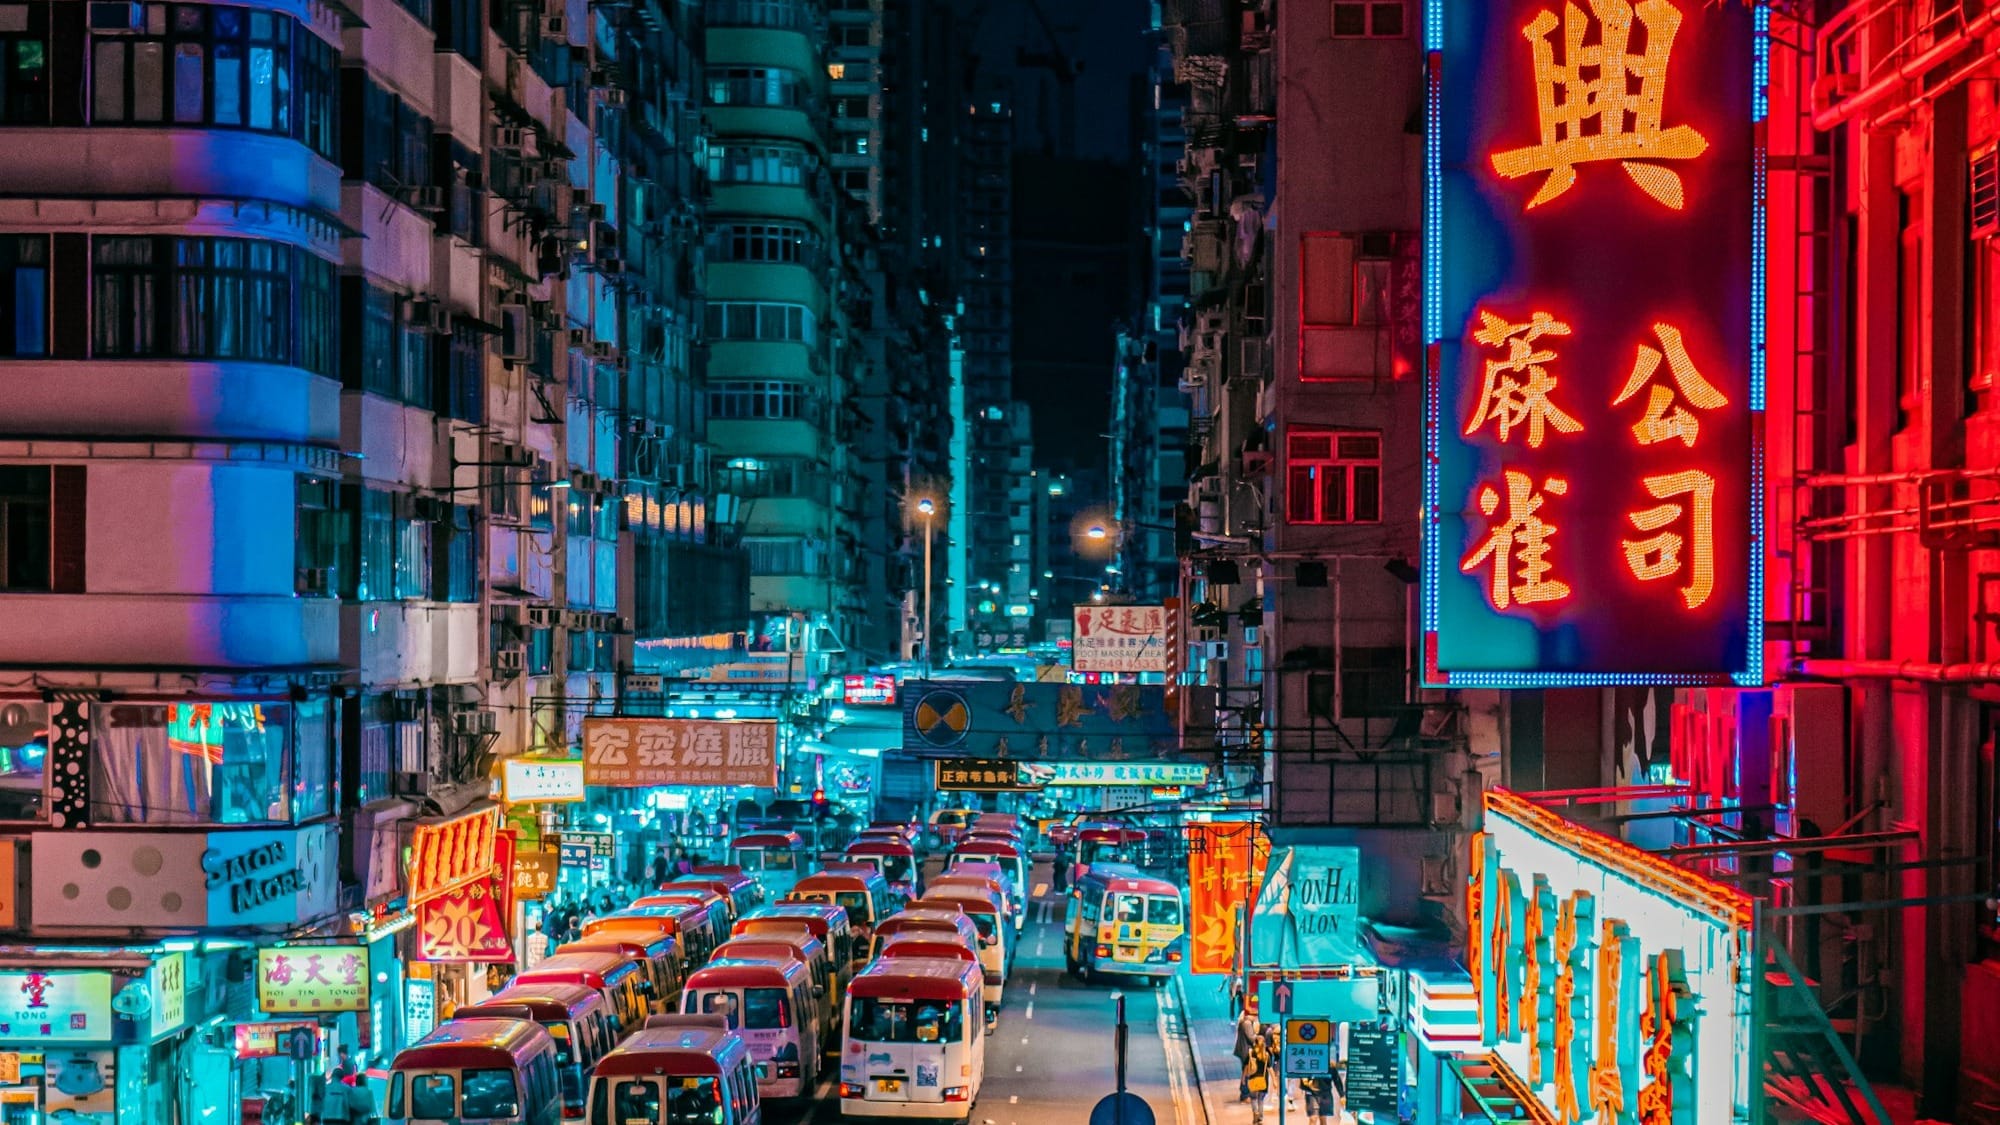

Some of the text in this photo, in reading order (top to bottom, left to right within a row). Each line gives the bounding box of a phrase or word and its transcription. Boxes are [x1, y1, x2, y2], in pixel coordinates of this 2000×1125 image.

[1490, 0, 1710, 211] 興
[1612, 322, 1729, 609] 公司
[589, 723, 770, 767] 宏發燒臘
[200, 840, 287, 891] SALON
[230, 868, 307, 914] MORE
[434, 915, 476, 946] 20
[1298, 914, 1341, 934] ALON
[264, 953, 366, 986] 海天堂
[20, 973, 54, 1008] 堂
[14, 1011, 48, 1020] TONG
[1291, 1047, 1323, 1056] 24 hrs
[1294, 1058, 1319, 1071] 全日
